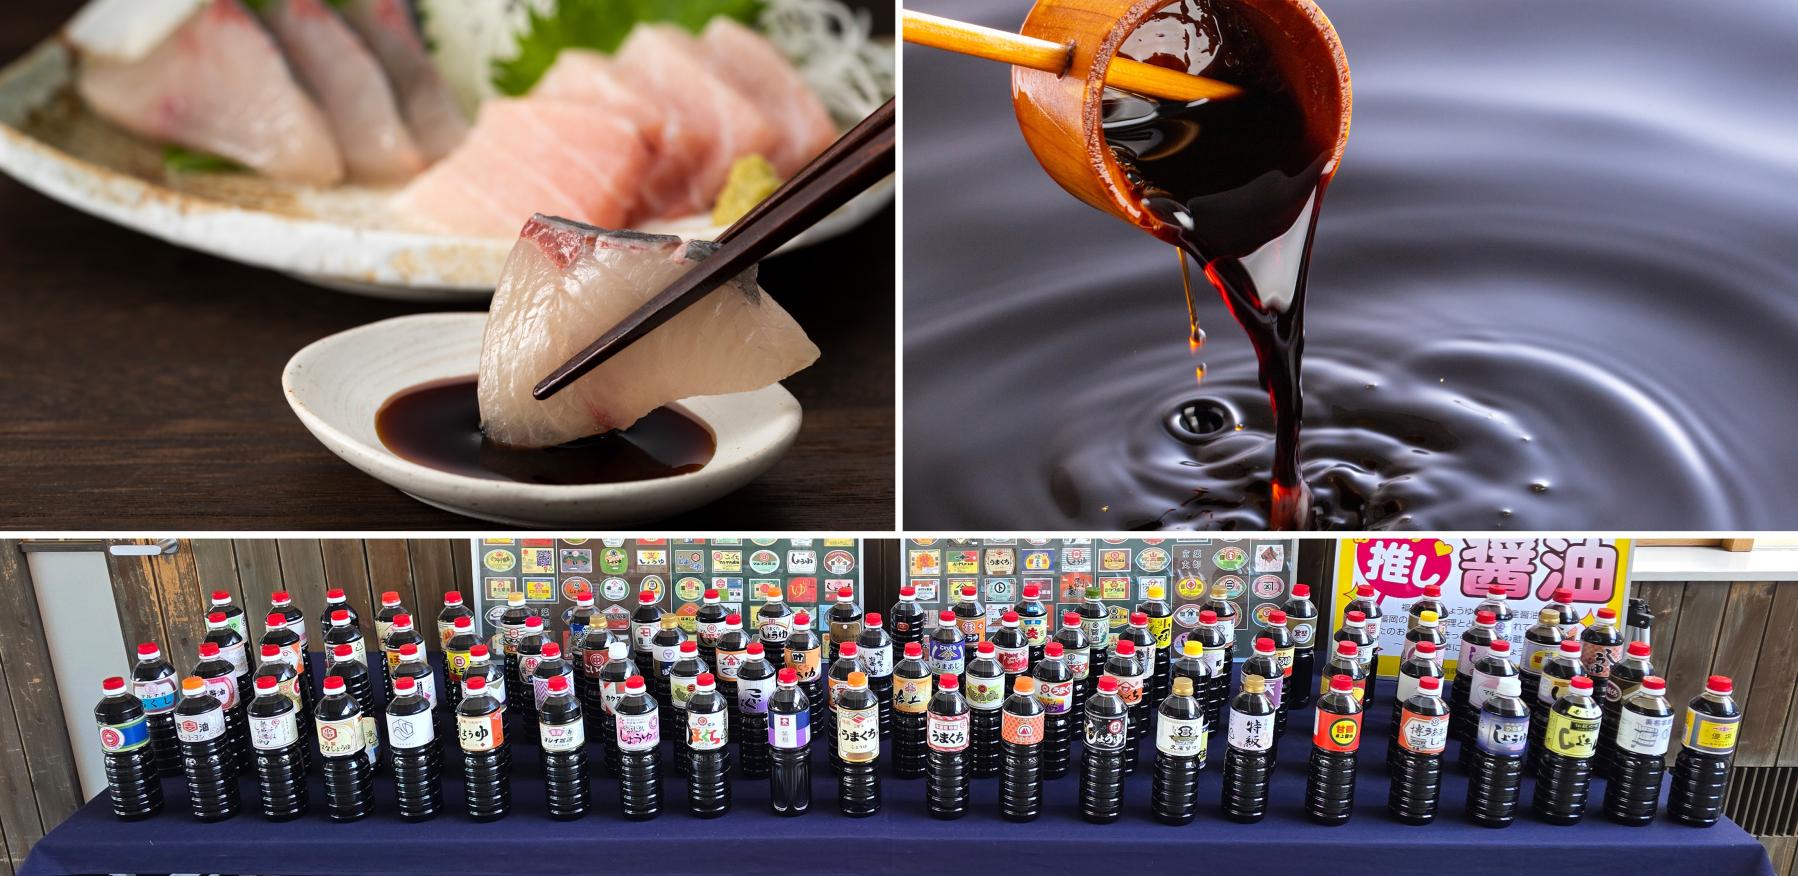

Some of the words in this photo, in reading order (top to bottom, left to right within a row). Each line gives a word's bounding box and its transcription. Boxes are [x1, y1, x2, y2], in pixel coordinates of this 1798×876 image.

[990, 558, 1010, 566] うまくち
[1366, 540, 1441, 588] 推し
[1459, 538, 1619, 603] 醤油
[620, 730, 652, 745] しょうゆ
[841, 729, 876, 742] うまくち
[931, 731, 964, 744] うまくち
[1246, 720, 1262, 748] 特級
